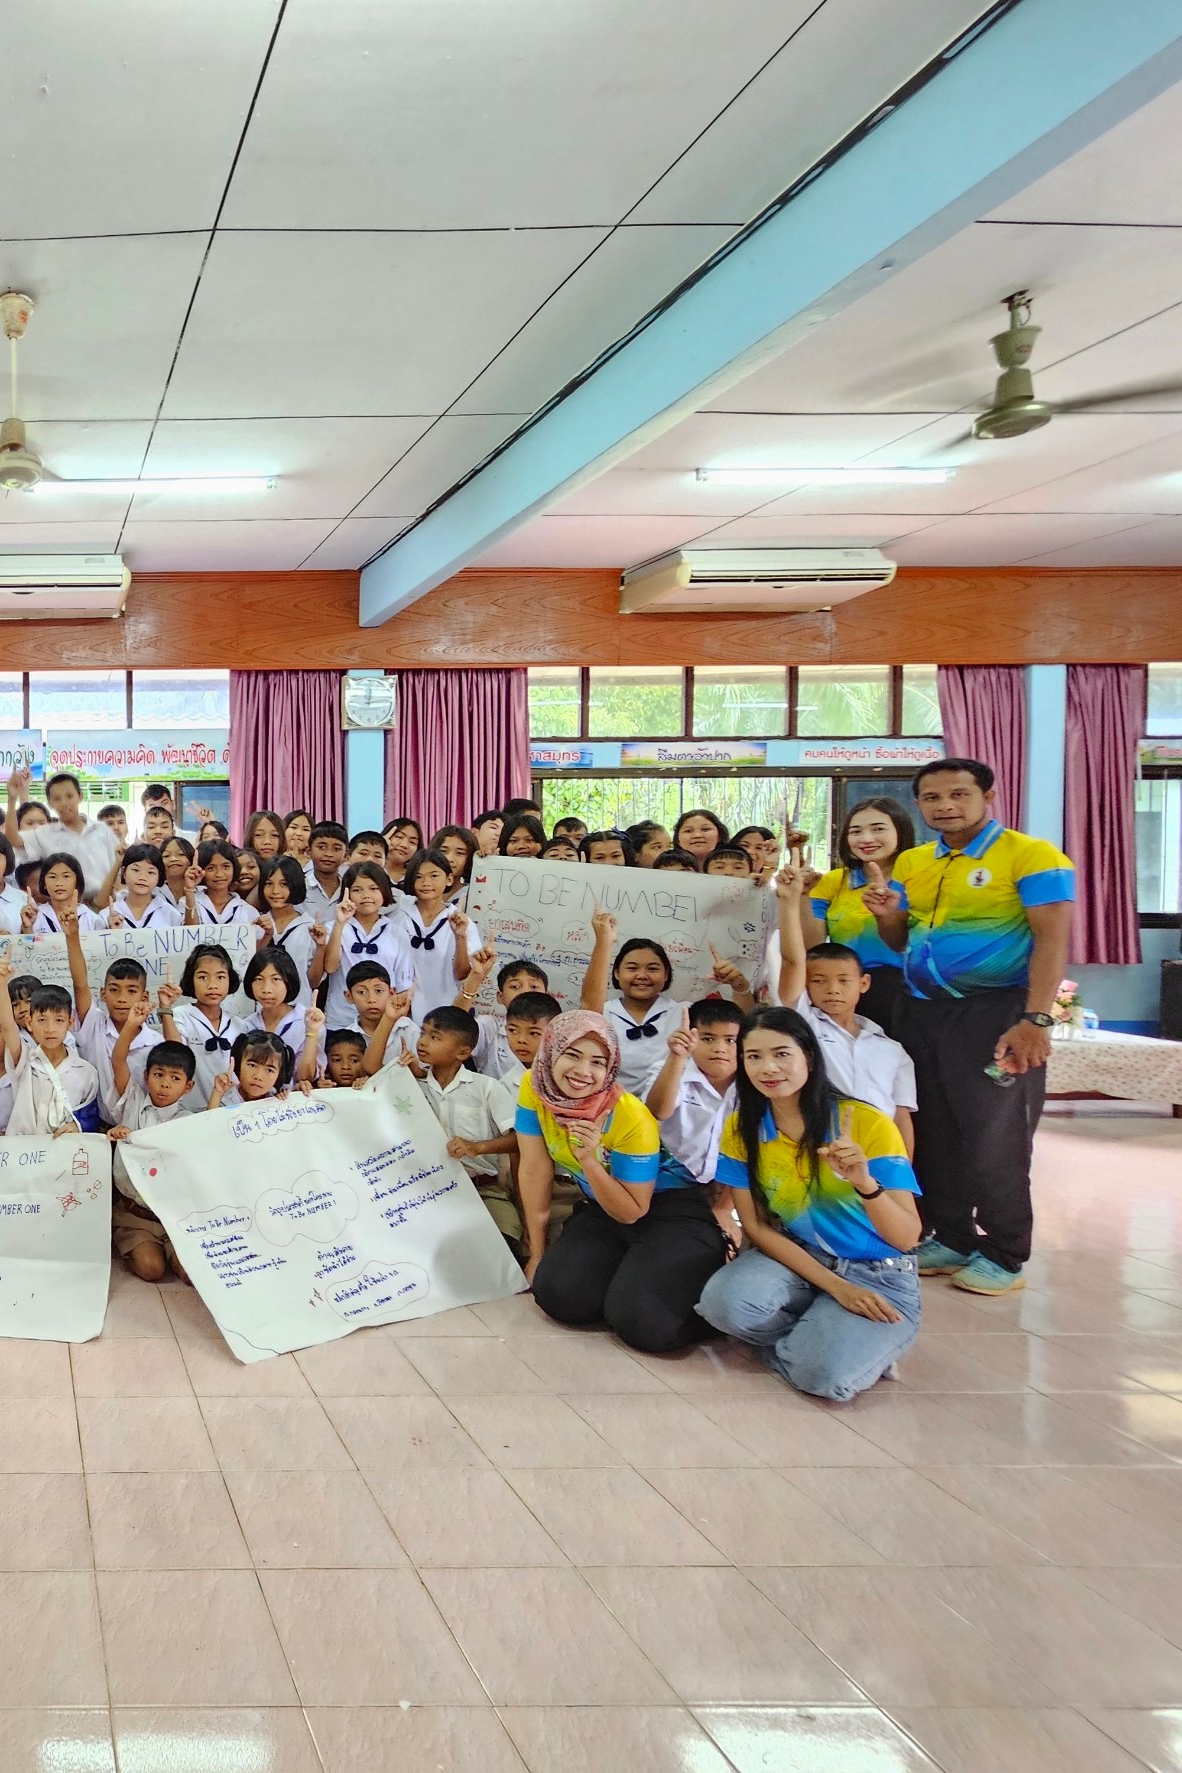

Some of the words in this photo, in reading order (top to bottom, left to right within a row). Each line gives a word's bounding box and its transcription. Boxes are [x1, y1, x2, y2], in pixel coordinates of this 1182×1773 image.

[804, 746, 871, 761] คบคนให้ดูหน้า
[490, 868, 530, 897] TO
[538, 873, 579, 907] BE
[154, 925, 249, 954] NUMBER
[18, 1150, 47, 1166] ONE
[24, 1204, 41, 1214] ONE
